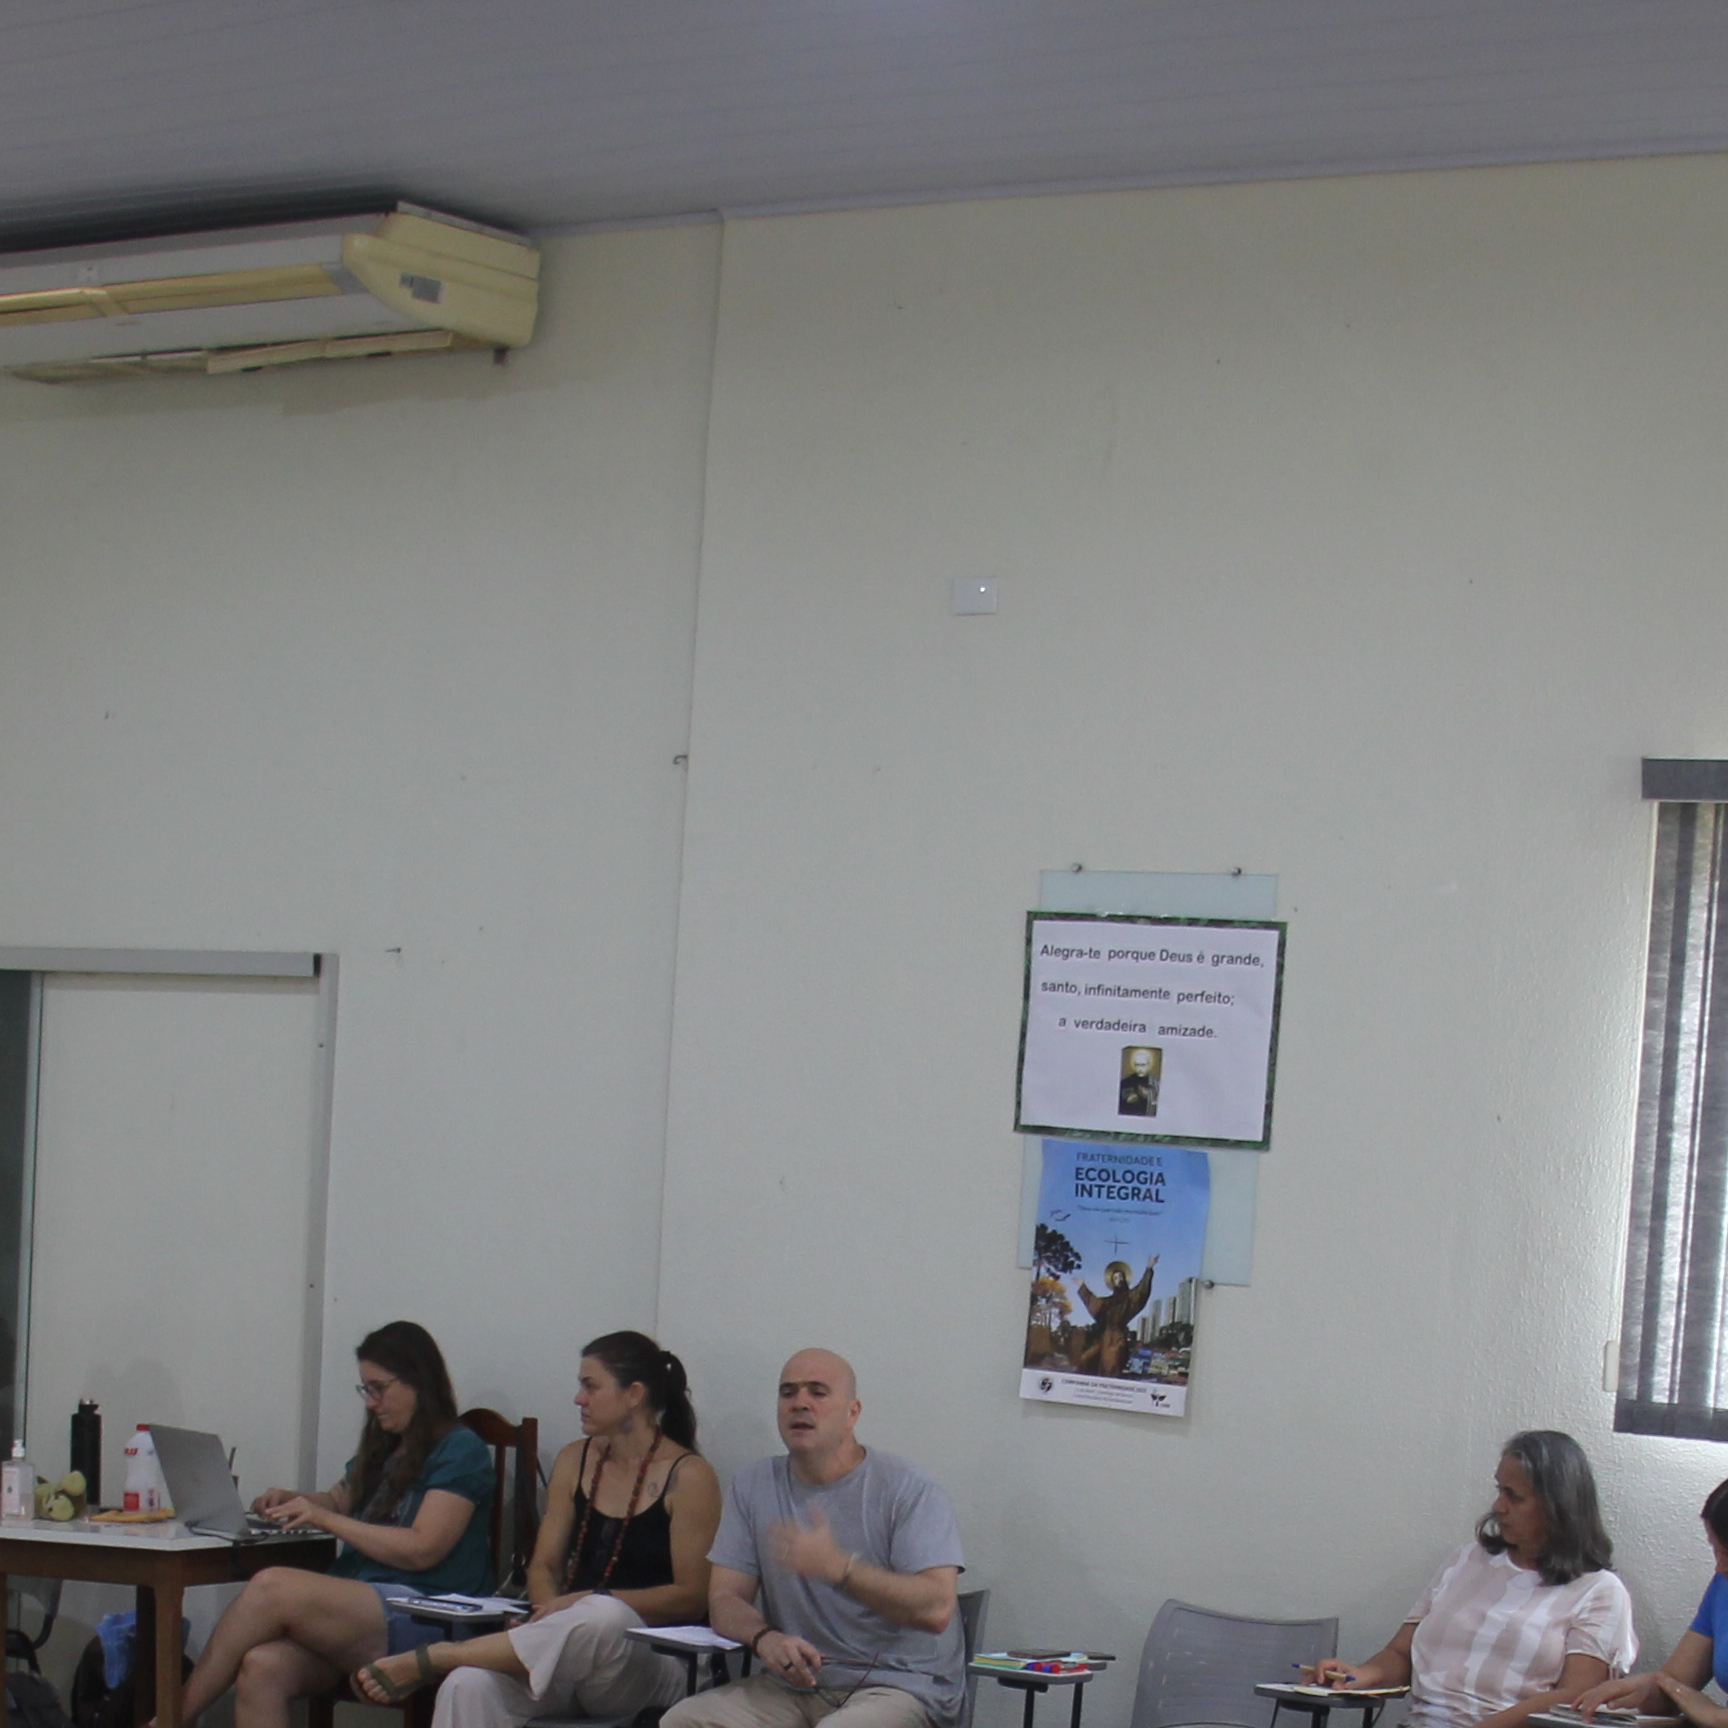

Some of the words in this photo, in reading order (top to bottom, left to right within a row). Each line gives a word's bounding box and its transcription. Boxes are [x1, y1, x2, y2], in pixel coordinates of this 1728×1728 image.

[1040, 944, 1101, 960] Alegra-te
[1107, 949, 1156, 963] porque
[1159, 949, 1193, 963] Deus
[1196, 951, 1205, 963] é
[1211, 953, 1264, 968] grande,
[1041, 981, 1080, 996] santo,
[1084, 983, 1170, 1000] infinitamente
[1176, 990, 1235, 1006] perfeito;
[1058, 1018, 1066, 1027] a
[1074, 1018, 1146, 1033] verdadeira
[1158, 1025, 1217, 1038] amizade.
[1076, 1152, 1154, 1166] FRATERNIDADE
[1156, 1157, 1163, 1166] E
[1075, 1167, 1166, 1186] ECOLOGIA
[1075, 1184, 1165, 1203] INTEGRAL
